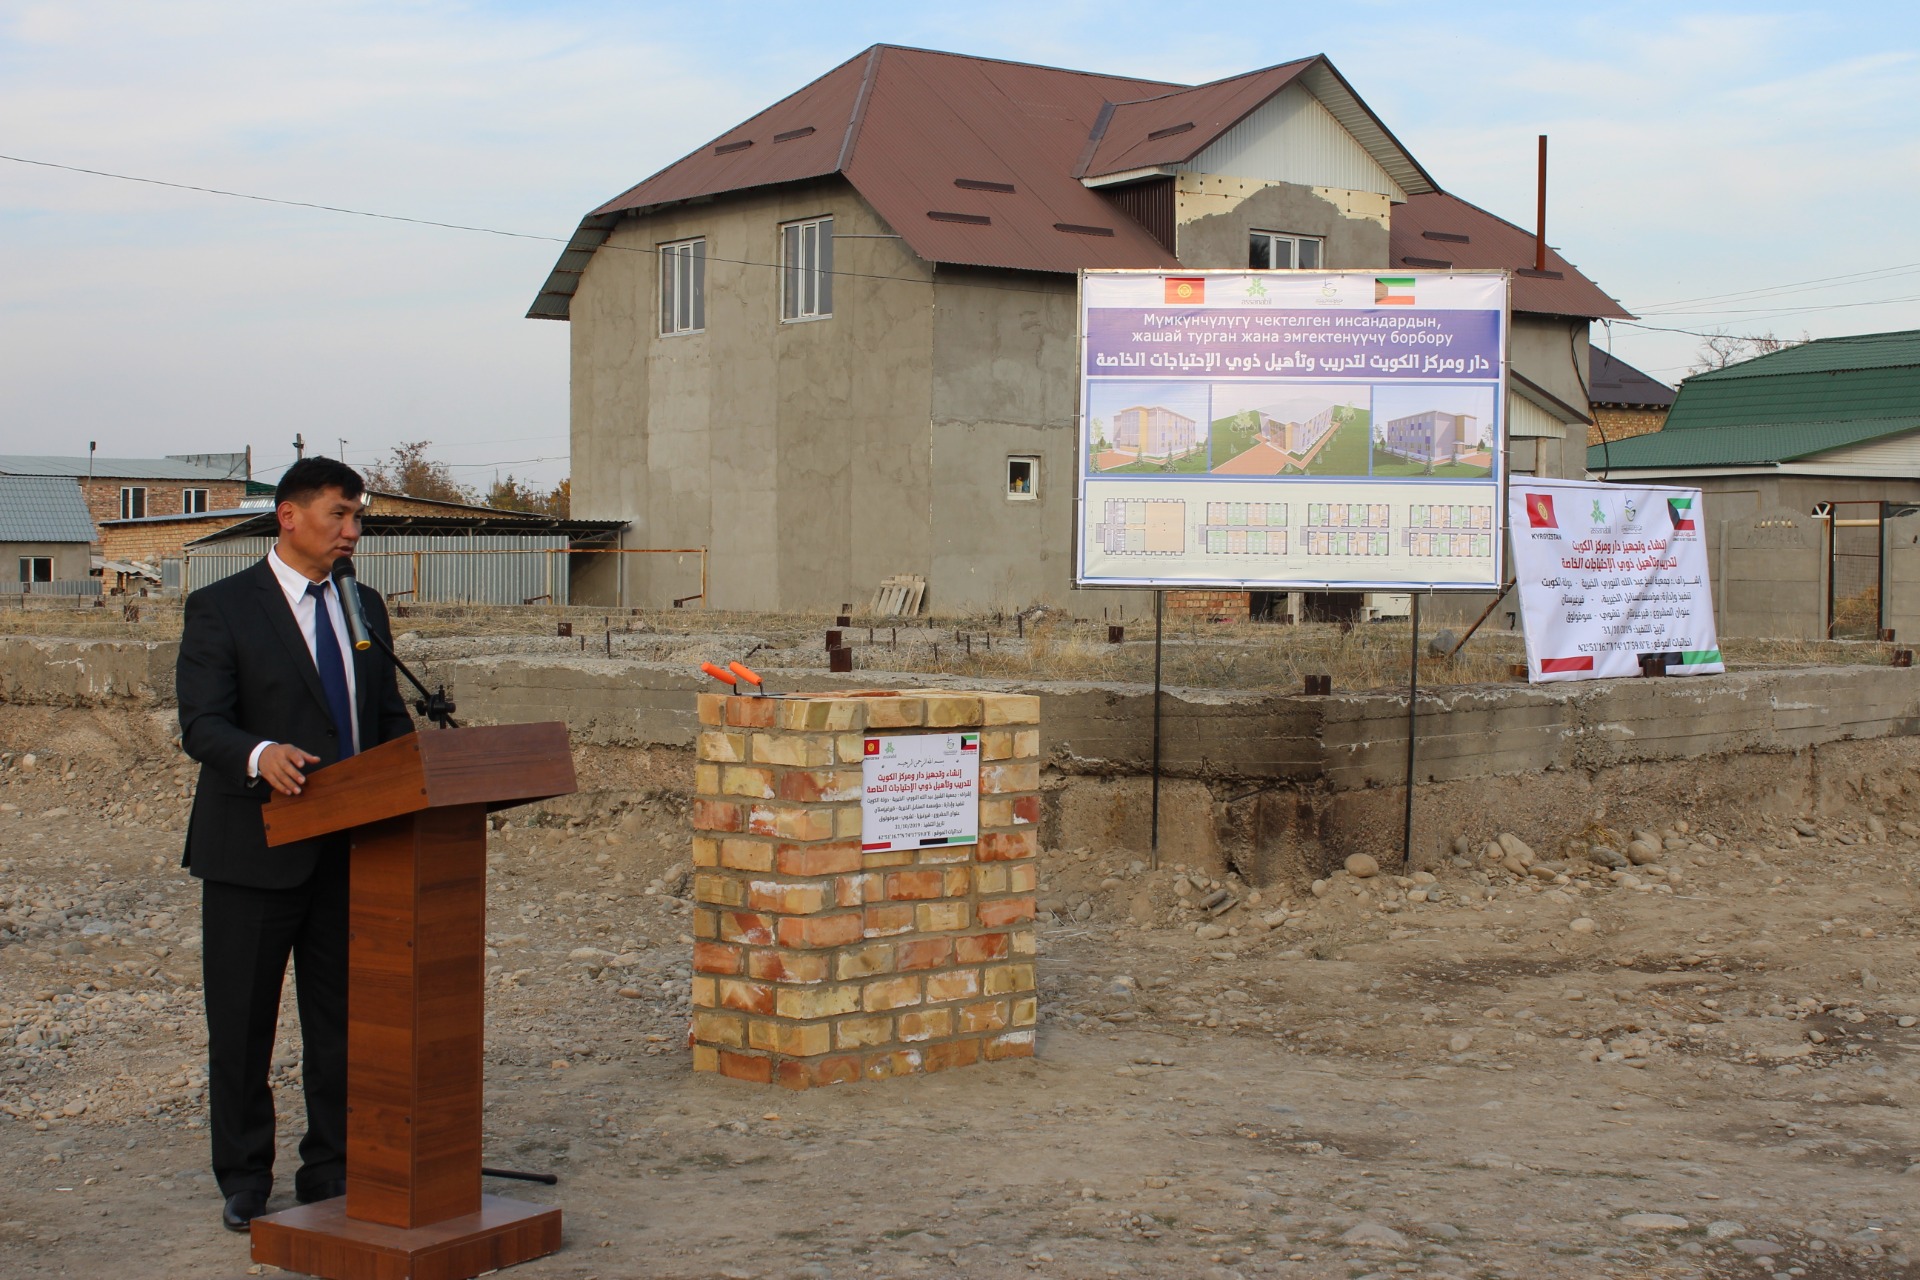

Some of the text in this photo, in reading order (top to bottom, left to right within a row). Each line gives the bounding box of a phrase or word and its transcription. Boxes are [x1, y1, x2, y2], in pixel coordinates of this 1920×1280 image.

[1144, 313, 1442, 329] Мүмкүнчүлүгү чектелген инсандардын,
[1132, 330, 1453, 347] жашай турган жана эмгектенүүчү борбору
[1096, 350, 1489, 373] دار ومركز الكويت لتدريب وتأهيل ذوي الإحتياجات الخاصة
[1572, 539, 1594, 554] الكويت
[1595, 540, 1611, 554] ومركز
[1612, 540, 1621, 554] دار
[1622, 540, 1646, 554] وتجهيز
[1561, 557, 1583, 569] الخاصة
[877, 773, 897, 782] الكويت
[866, 784, 887, 793] الخاصة
